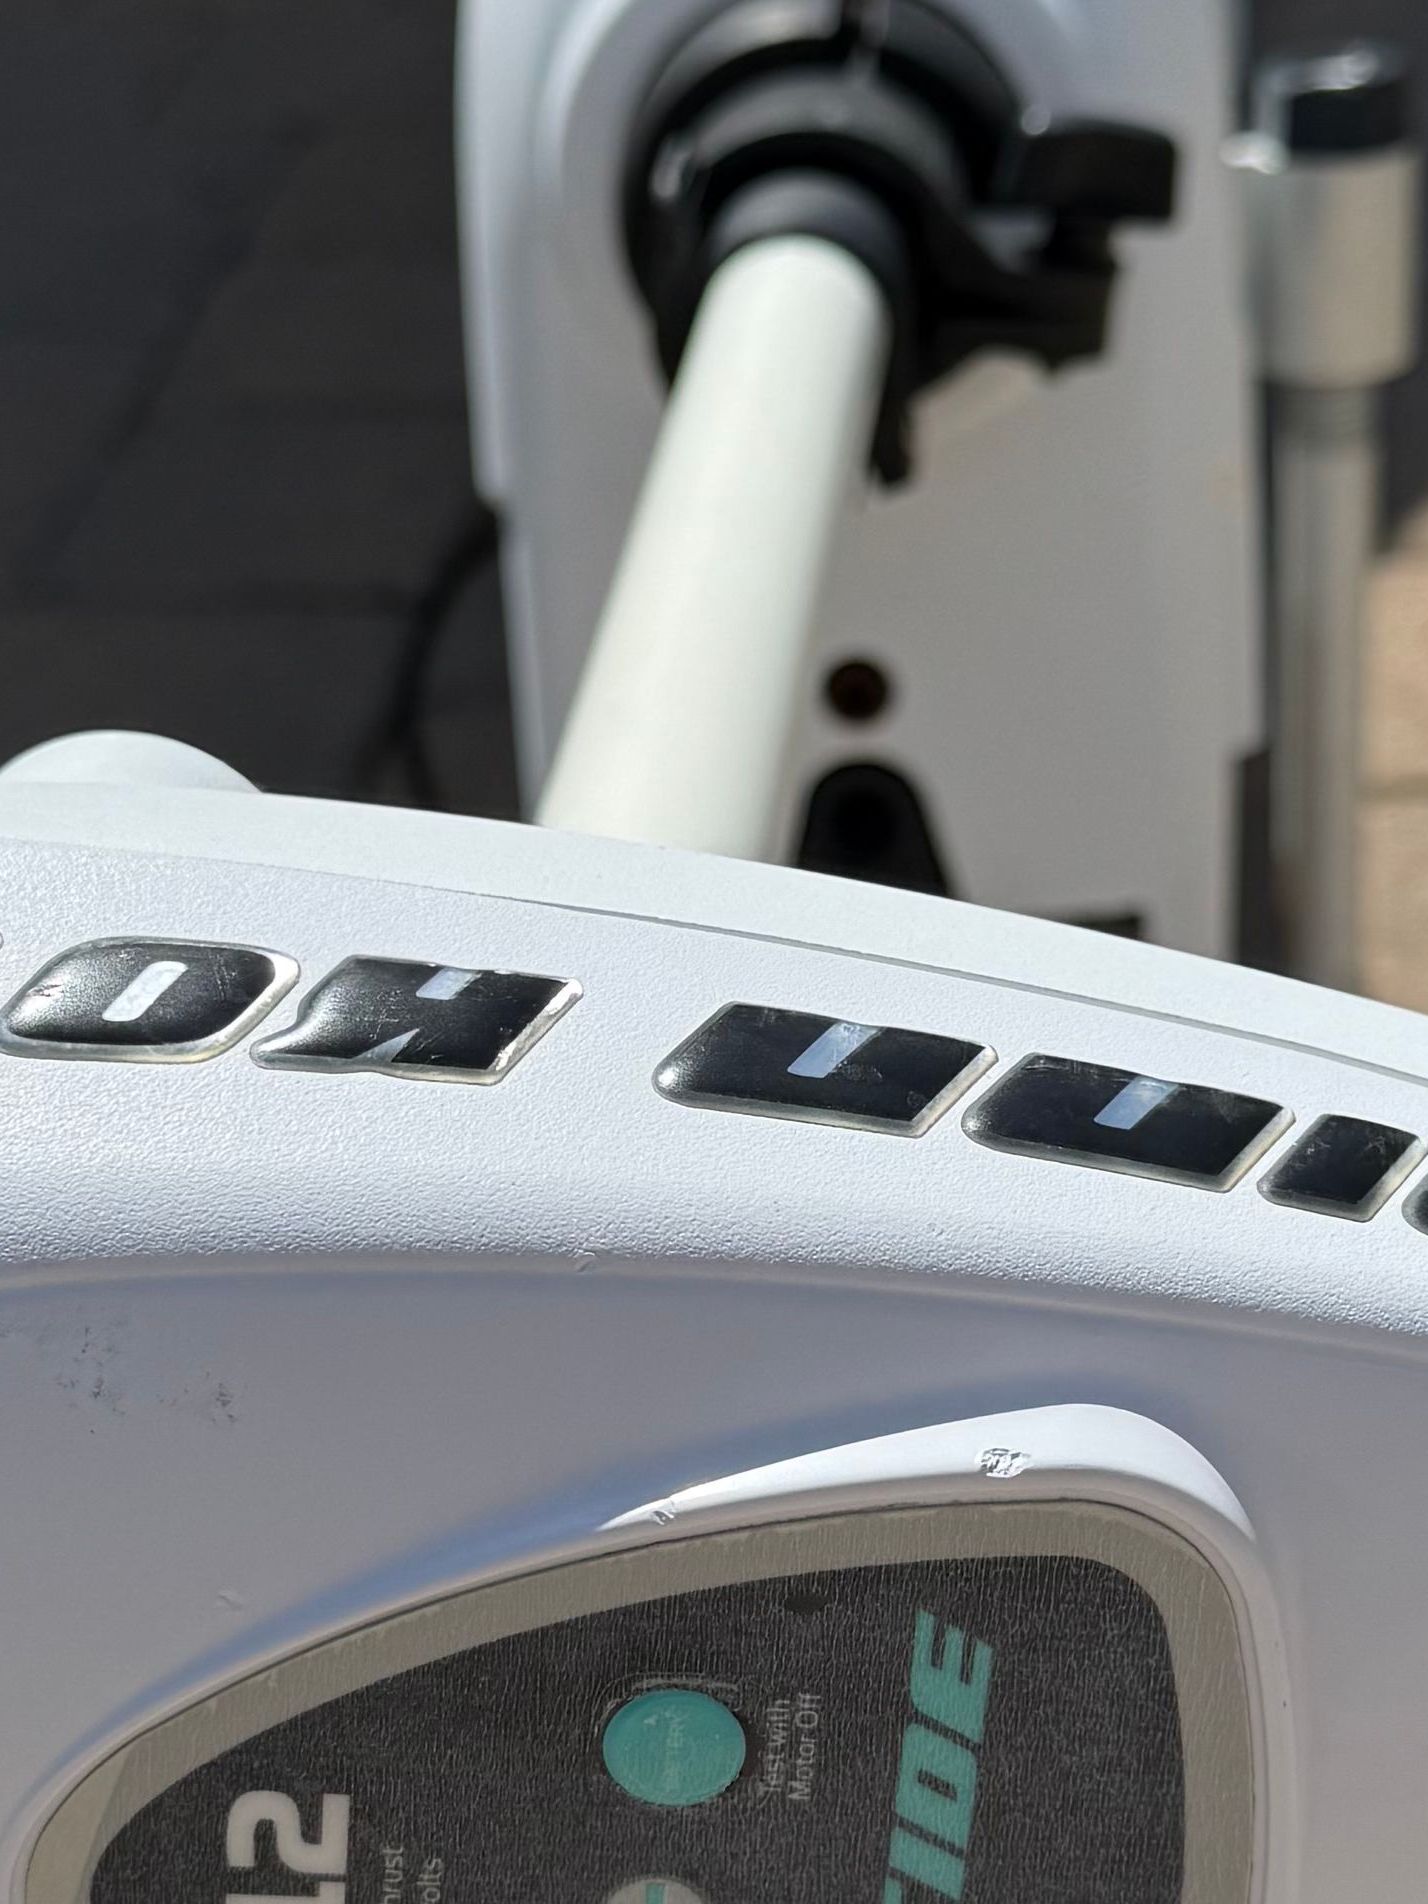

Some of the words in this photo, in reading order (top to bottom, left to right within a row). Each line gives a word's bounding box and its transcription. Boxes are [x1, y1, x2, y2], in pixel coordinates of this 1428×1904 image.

[764, 1699, 792, 1748] with
[790, 1692, 821, 1730] Off
[762, 1752, 790, 1794] Test
[786, 1733, 818, 1801] Motor
